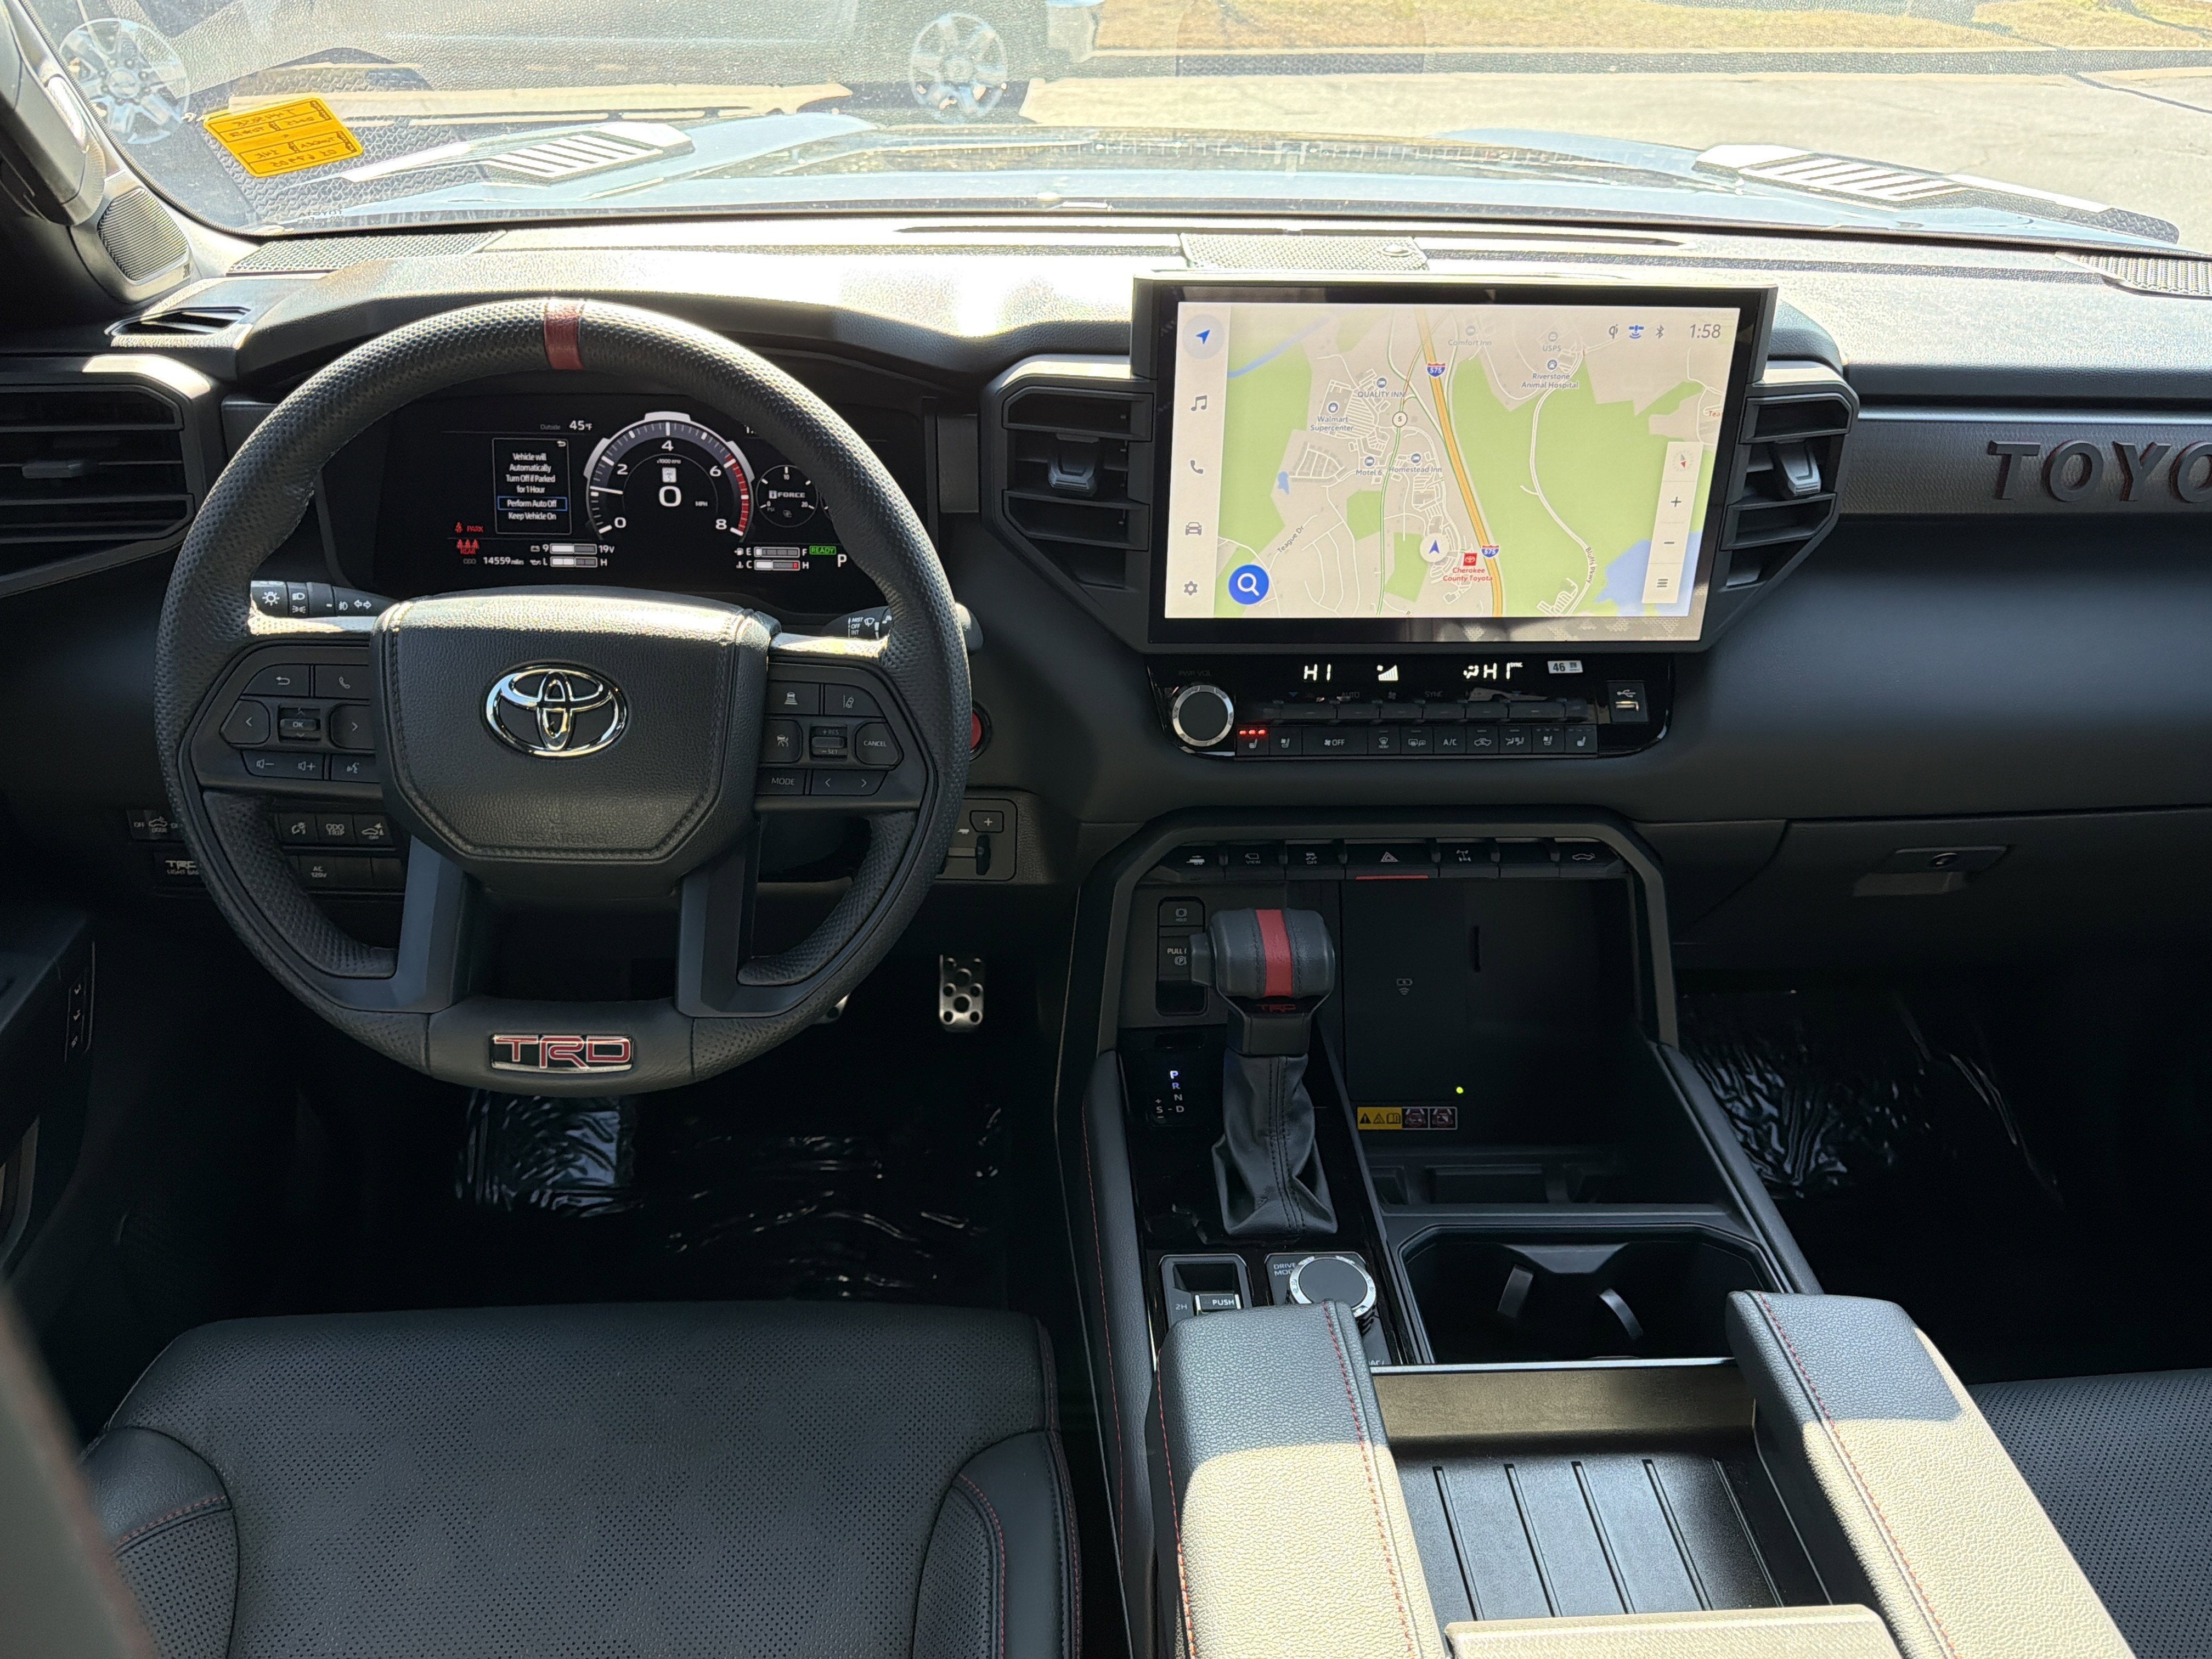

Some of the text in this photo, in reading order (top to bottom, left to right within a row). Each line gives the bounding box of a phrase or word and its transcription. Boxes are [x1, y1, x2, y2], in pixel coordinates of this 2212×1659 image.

[1690, 324, 1721, 338] 1:58
[1548, 381, 1579, 390] Hospital
[662, 439, 674, 452] 4
[512, 453, 547, 461] Vehicle will
[509, 464, 551, 473] Automatically
[617, 464, 628, 475] 2
[709, 465, 722, 477] 6
[506, 474, 520, 482] Turn
[520, 474, 530, 482] Off
[535, 474, 556, 482] Parked
[517, 485, 526, 493] for
[530, 485, 545, 493] Hour
[659, 486, 681, 507] 0
[507, 499, 557, 507] Perform Auto Off
[508, 512, 557, 521] Keep Vehicle On
[614, 517, 627, 529] 0
[715, 519, 727, 530] 8
[1277, 534, 1298, 554] Teague
[746, 548, 752, 556] E
[802, 548, 808, 556] F
[483, 557, 511, 565] 14559
[543, 558, 548, 566] L
[600, 557, 607, 566] H
[746, 561, 752, 569] C
[838, 554, 847, 567] P
[802, 561, 809, 570] H
[1303, 663, 1331, 681] HI
[1553, 663, 1566, 672] 46
[1331, 738, 1345, 747] OFF
[1443, 738, 1458, 747] A/C
[771, 777, 795, 785] MODE
[493, 1034, 631, 1069] TRD
[1170, 1070, 1179, 1079] P
